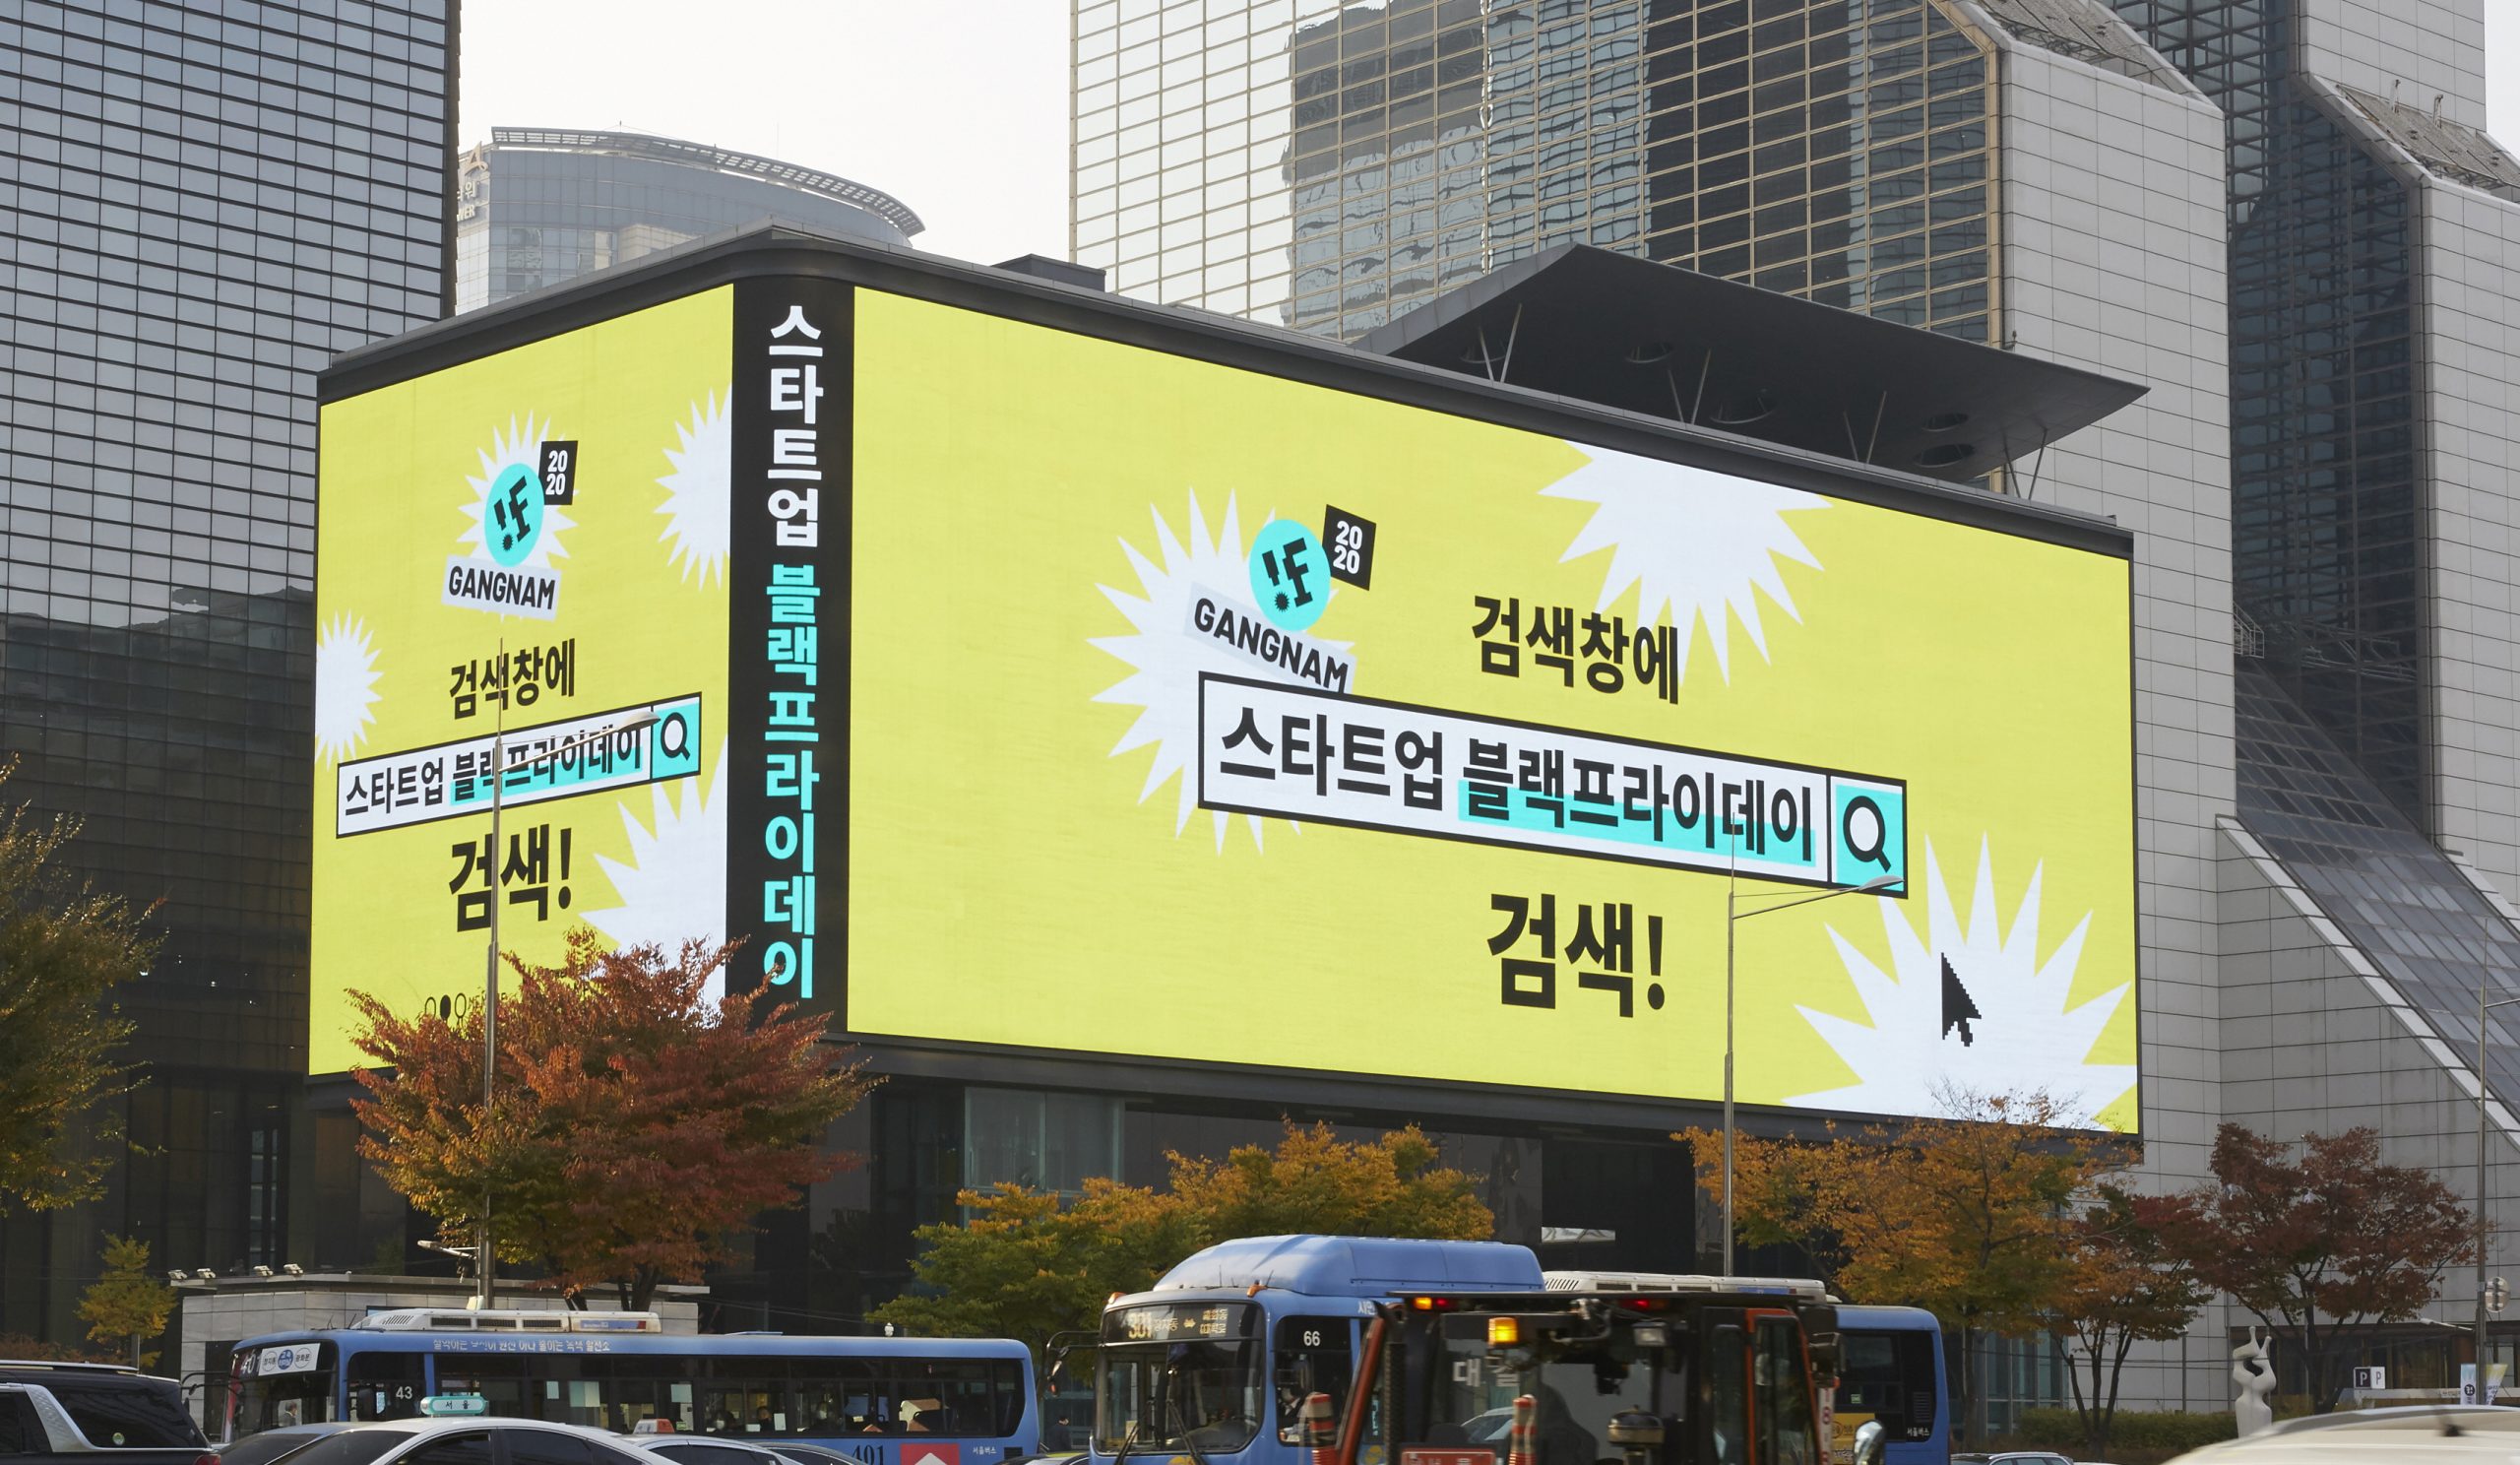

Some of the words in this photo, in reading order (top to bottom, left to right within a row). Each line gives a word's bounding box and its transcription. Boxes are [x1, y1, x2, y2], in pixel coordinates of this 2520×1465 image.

[768, 305, 824, 546] 스타트업
[547, 449, 568, 474] 20
[544, 473, 566, 496] 20
[1335, 520, 1363, 550] 20
[1332, 545, 1360, 575] 20
[448, 565, 556, 610] GANGNAM
[1193, 597, 1350, 694] GANGNAM
[1471, 594, 1679, 706] 검색창에
[449, 637, 575, 720] 검색창에
[345, 756, 444, 816] 스타트업
[452, 727, 642, 802] 블랙프라이데이
[764, 564, 821, 999] 블랙프라이데이
[1220, 706, 1443, 812] 스타트업
[1462, 737, 1812, 862] 블랙프라이데이
[449, 822, 573, 933] 검색!
[1486, 892, 1666, 1019] 검색!
[1303, 1330, 1321, 1346] 66
[395, 1386, 412, 1400] 43
[2360, 1371, 2368, 1385] P
[2375, 1371, 2382, 1385] P
[852, 1444, 884, 1465] 401
